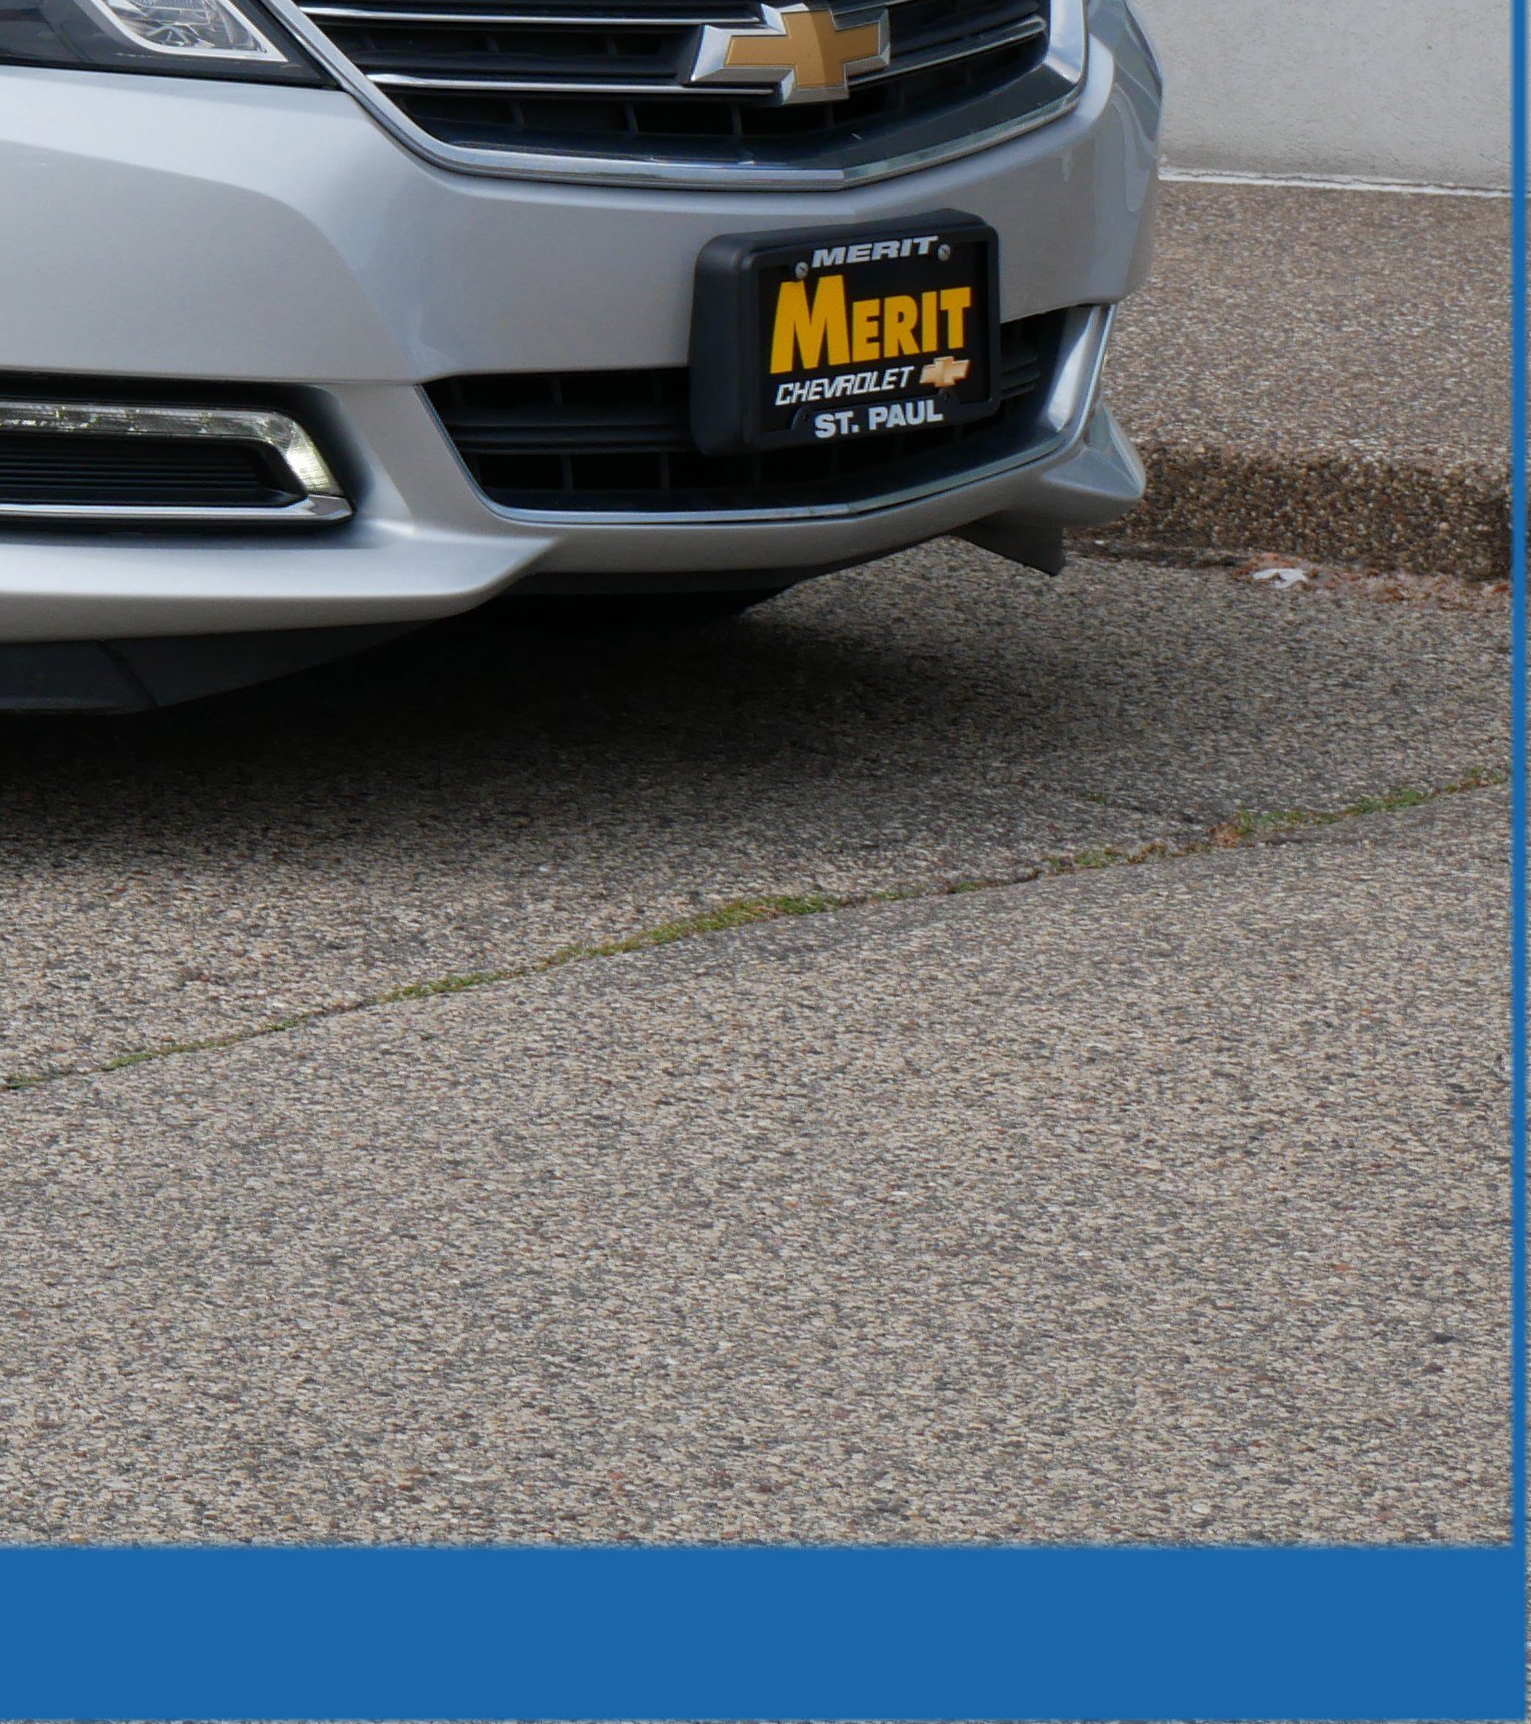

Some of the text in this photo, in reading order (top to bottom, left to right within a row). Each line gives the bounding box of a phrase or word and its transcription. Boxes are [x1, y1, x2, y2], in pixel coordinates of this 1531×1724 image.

[811, 235, 938, 268] MERIT
[770, 274, 972, 374] MERIT
[775, 366, 915, 407] CHEVROLET
[814, 398, 944, 439] ST. PAUL
